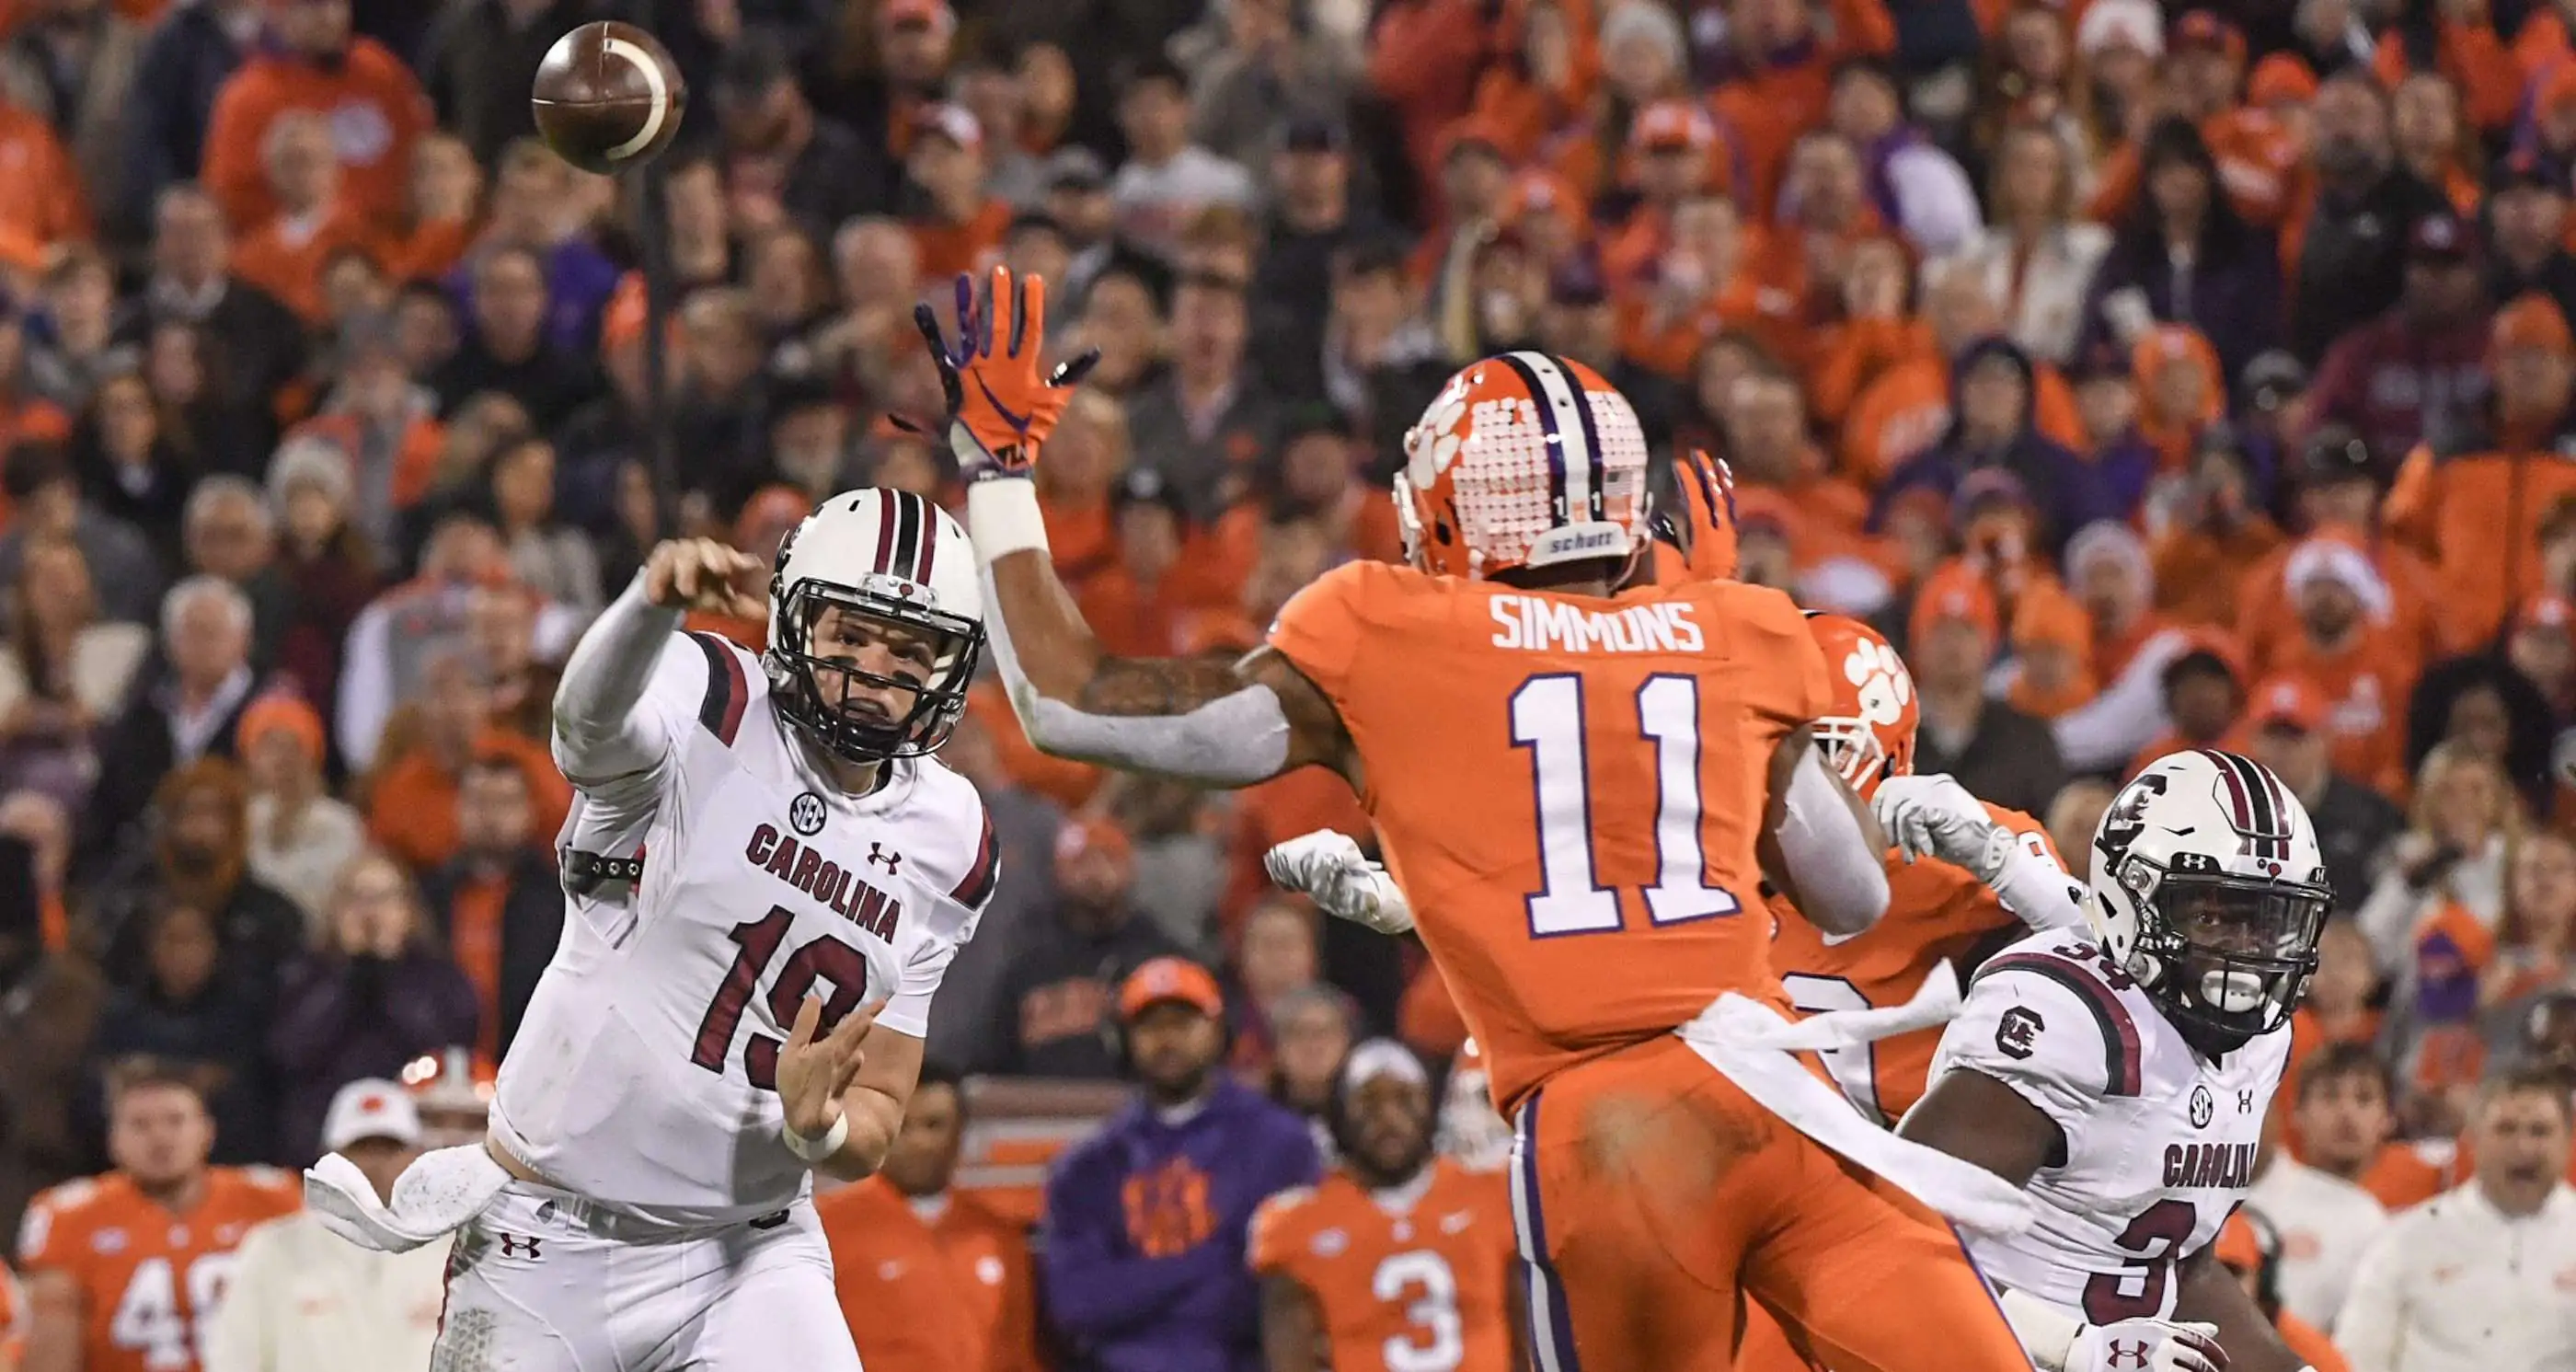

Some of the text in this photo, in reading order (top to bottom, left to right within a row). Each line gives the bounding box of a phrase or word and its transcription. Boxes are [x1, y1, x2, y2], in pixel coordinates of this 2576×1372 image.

[1549, 531, 1614, 553] schutt
[1553, 490, 1602, 517] 1 1
[1489, 594, 1705, 651] SIMMONS
[791, 792, 826, 836] SEC
[1507, 672, 1742, 940] 11
[746, 824, 901, 945] CAROLINA
[691, 904, 868, 1091] 19
[1372, 1249, 1464, 1371] 3
